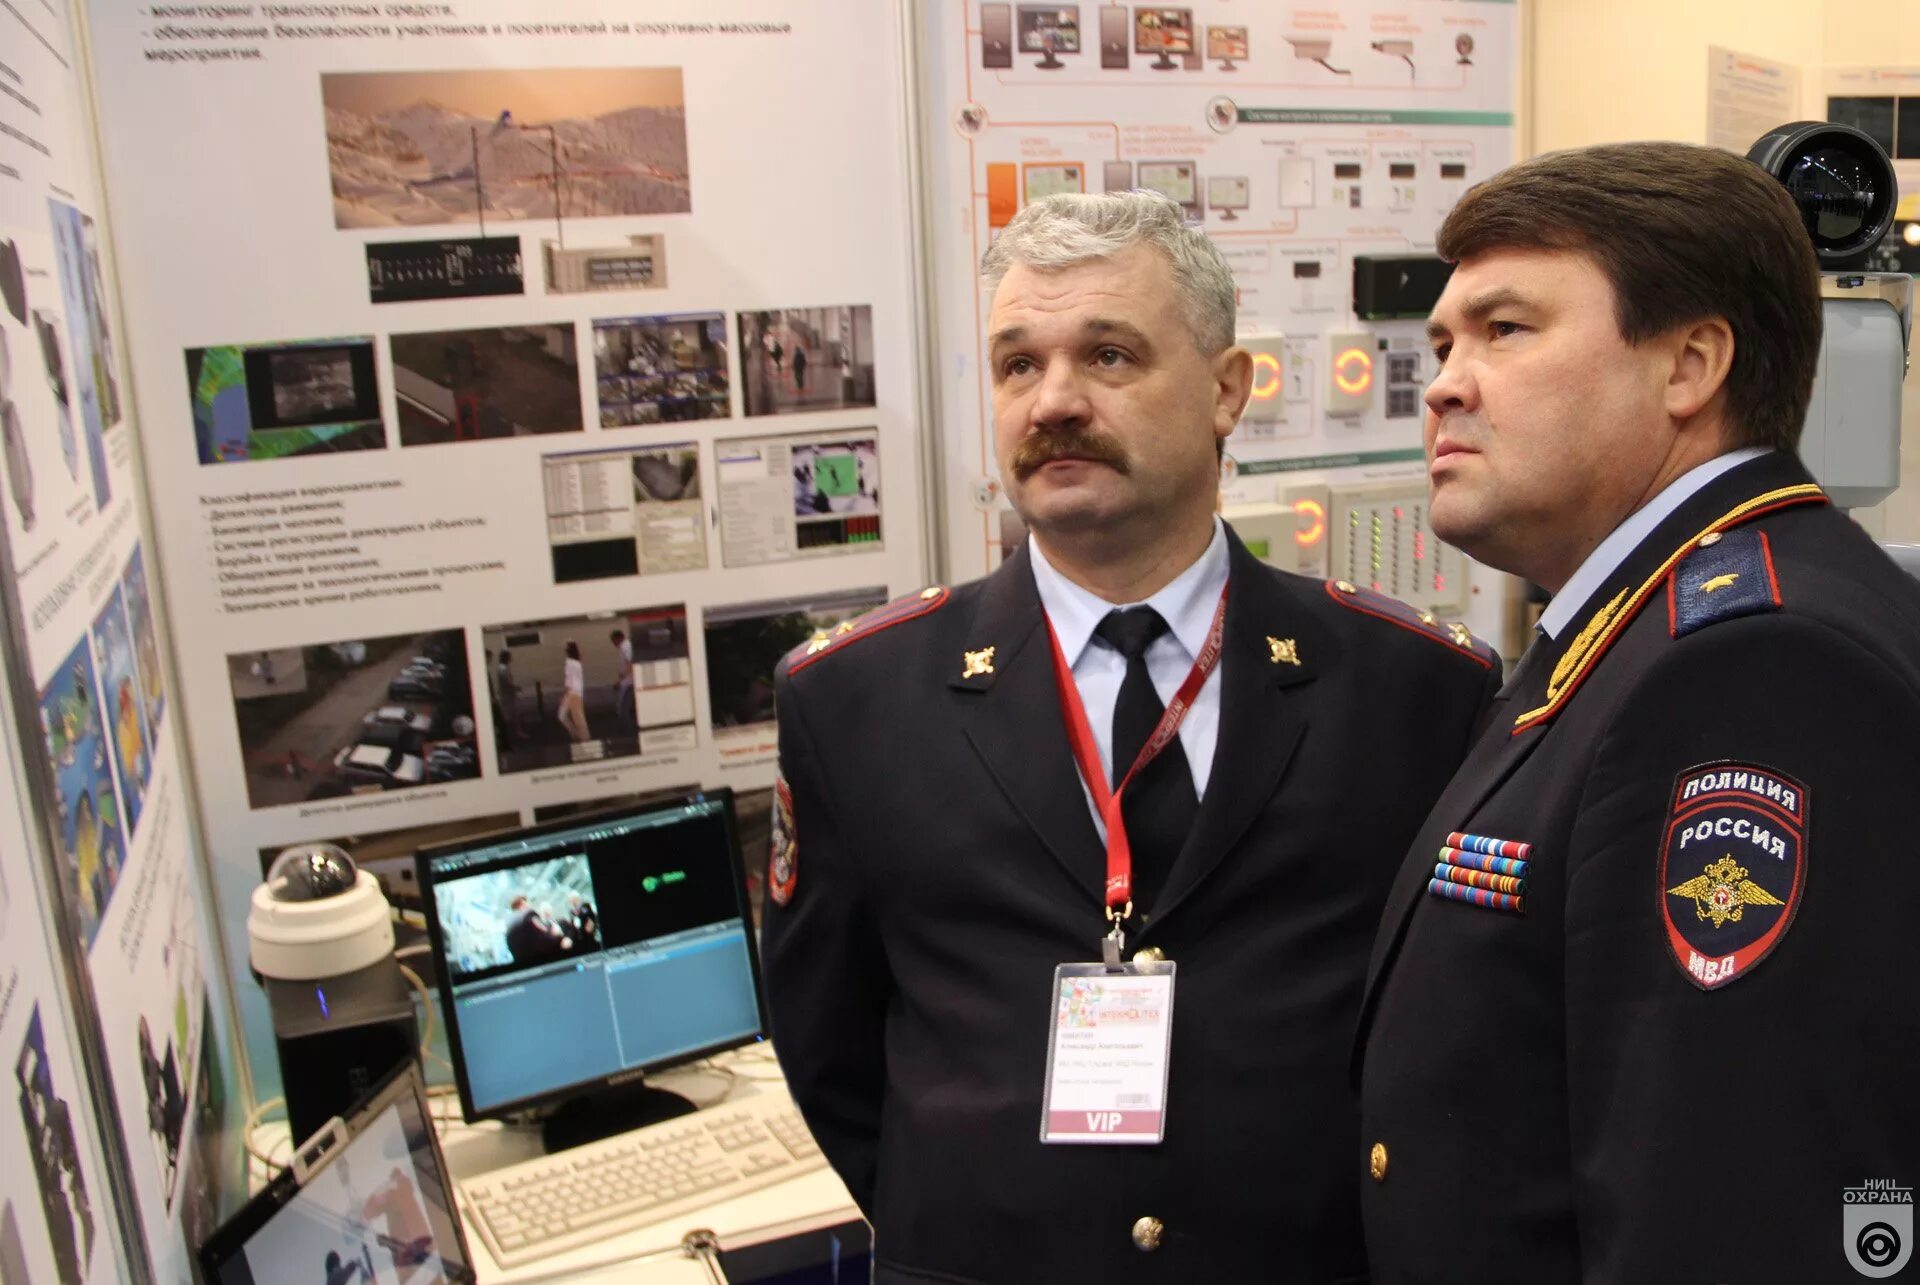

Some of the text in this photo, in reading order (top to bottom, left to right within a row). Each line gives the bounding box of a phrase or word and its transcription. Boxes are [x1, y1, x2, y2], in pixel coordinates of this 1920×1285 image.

[152, 6, 253, 20] мониторинг
[274, 23, 390, 39] безопасности
[1683, 772, 1796, 811] ПОЛИЦИЯ
[1680, 817, 1786, 861] РОССИЯ
[1688, 950, 1736, 985] МВД
[1086, 1111, 1122, 1132] VIP
